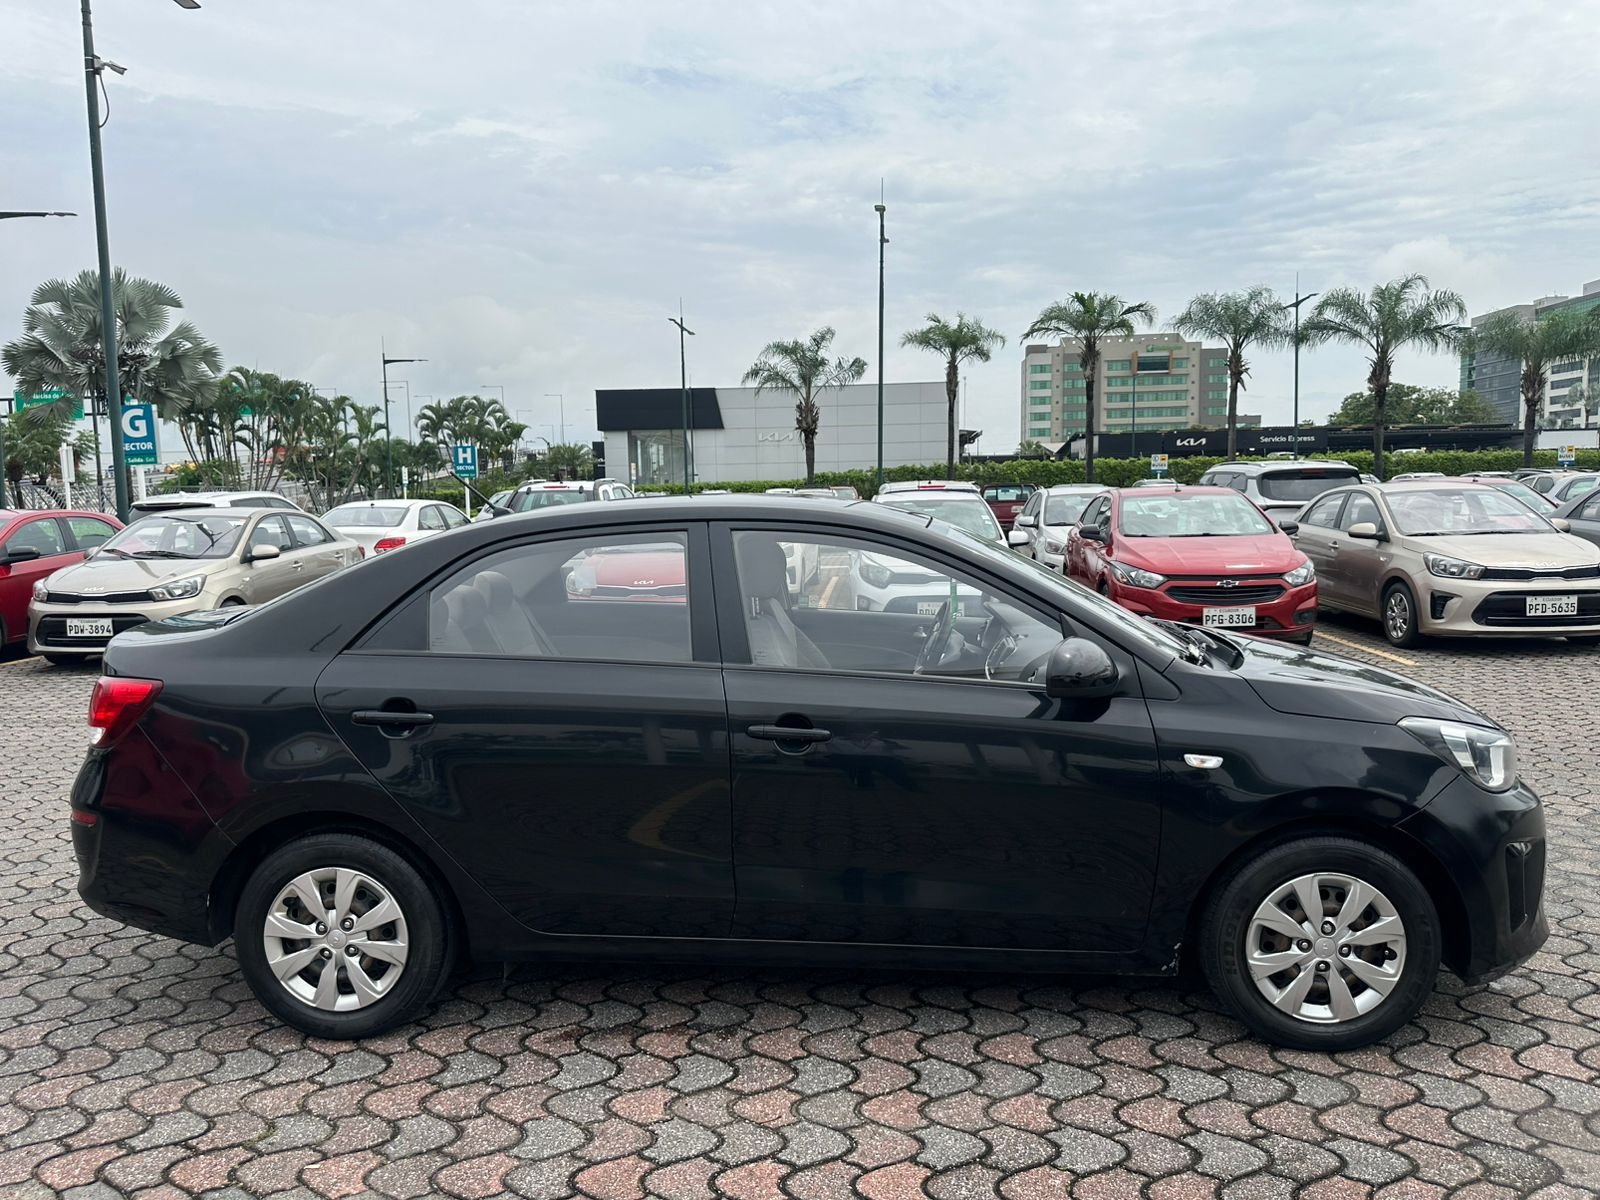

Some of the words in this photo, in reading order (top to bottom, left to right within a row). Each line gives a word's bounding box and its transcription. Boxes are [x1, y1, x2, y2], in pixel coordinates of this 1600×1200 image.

[121, 408, 148, 438] G
[758, 432, 794, 441] KIA
[1176, 438, 1207, 446] KIA
[1259, 435, 1287, 443] Servicio
[123, 442, 153, 451] ECTOR
[457, 447, 472, 464] H
[1528, 603, 1576, 614] PFD-5635
[1205, 614, 1254, 625] PFG-8306
[68, 624, 112, 635] PDW-3894
